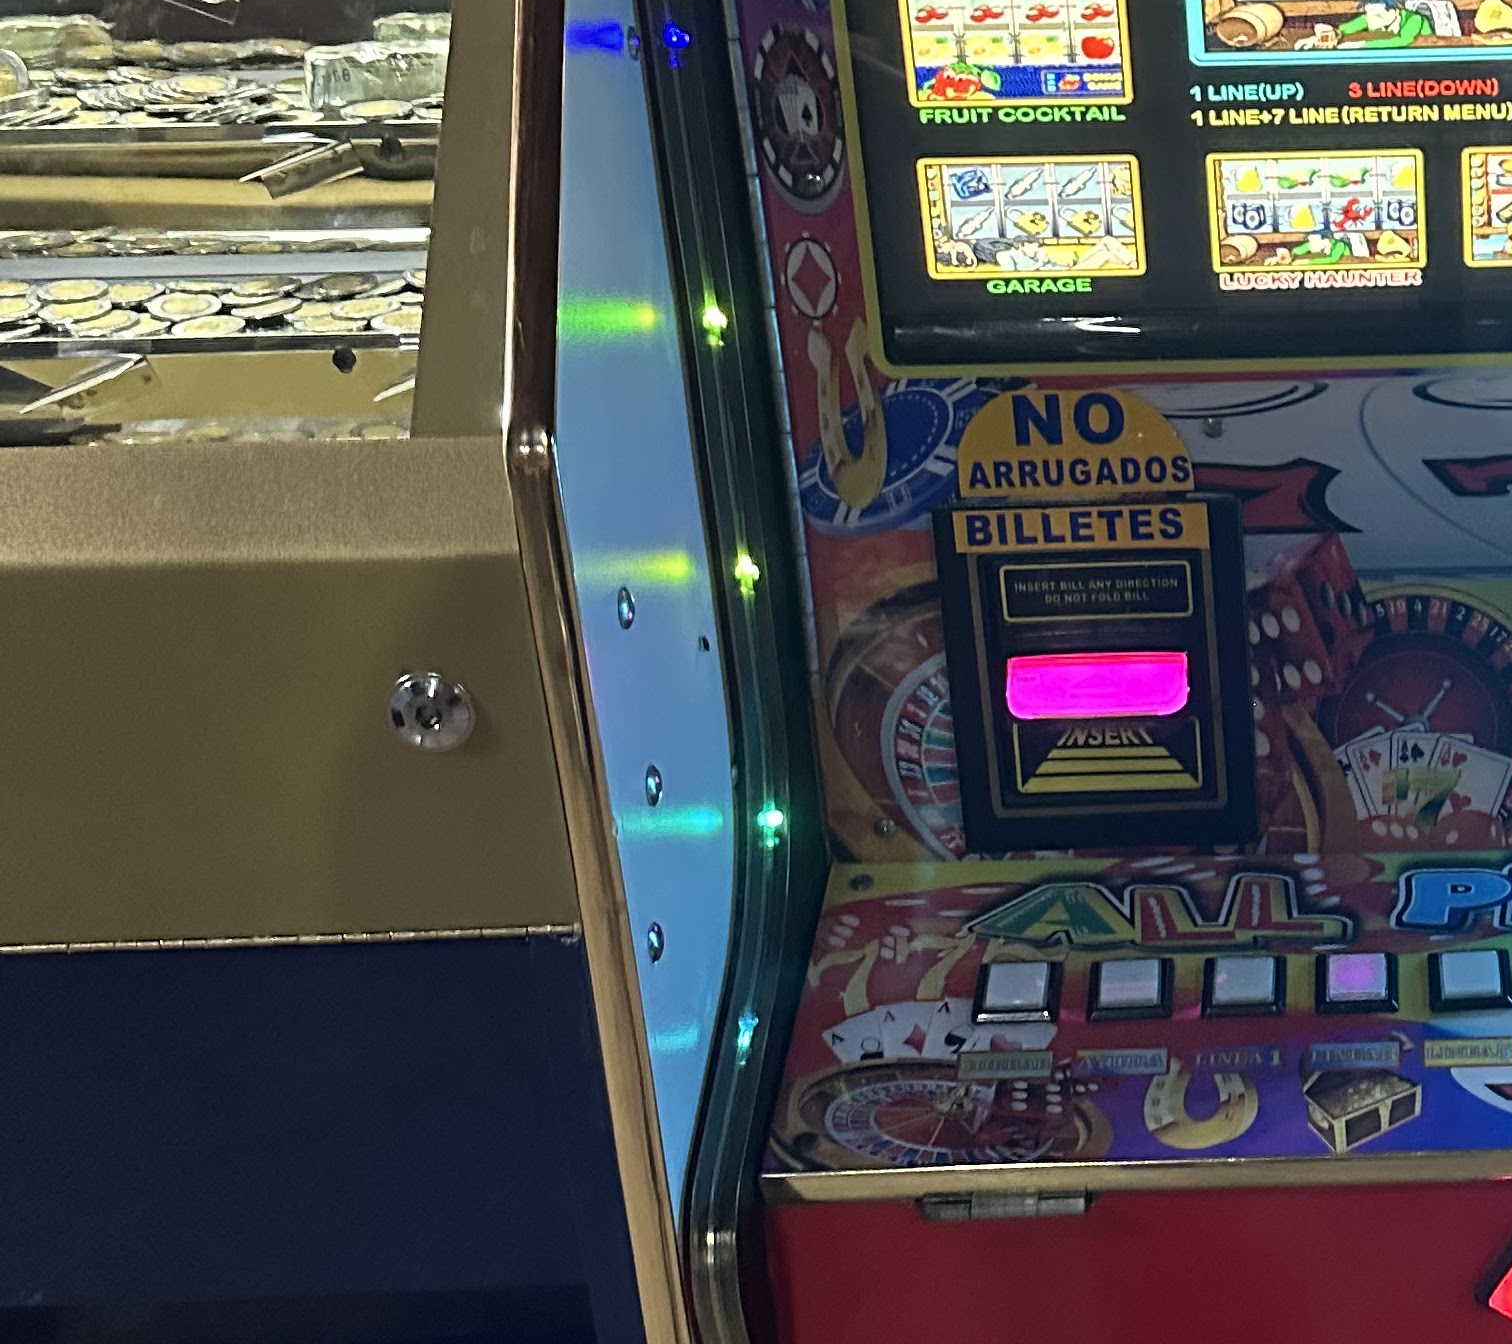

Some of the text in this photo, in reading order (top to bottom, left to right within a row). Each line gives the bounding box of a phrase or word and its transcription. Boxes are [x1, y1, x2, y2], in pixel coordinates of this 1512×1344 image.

[1189, 81, 1304, 104] 1 LINE(UP)
[1348, 77, 1500, 99] 3 LINE(DOWN)
[919, 105, 1127, 125] FRUIT COCKTAIL
[1190, 111, 1203, 127] 1
[986, 277, 1093, 295] GARAGE
[1218, 268, 1423, 291] LUCKY HAUNTER
[1012, 393, 1126, 446] NO
[968, 455, 1192, 490] ARRUGADOS
[966, 507, 1184, 546] BILLETES
[1015, 577, 1178, 593] INSERT BILL ANY DIRECTION
[1045, 591, 1149, 605] DO NOT FOLD BILL
[1056, 725, 1154, 747] INSERT
[961, 872, 1353, 947] ALL
[1195, 1051, 1262, 1066] LINEA
